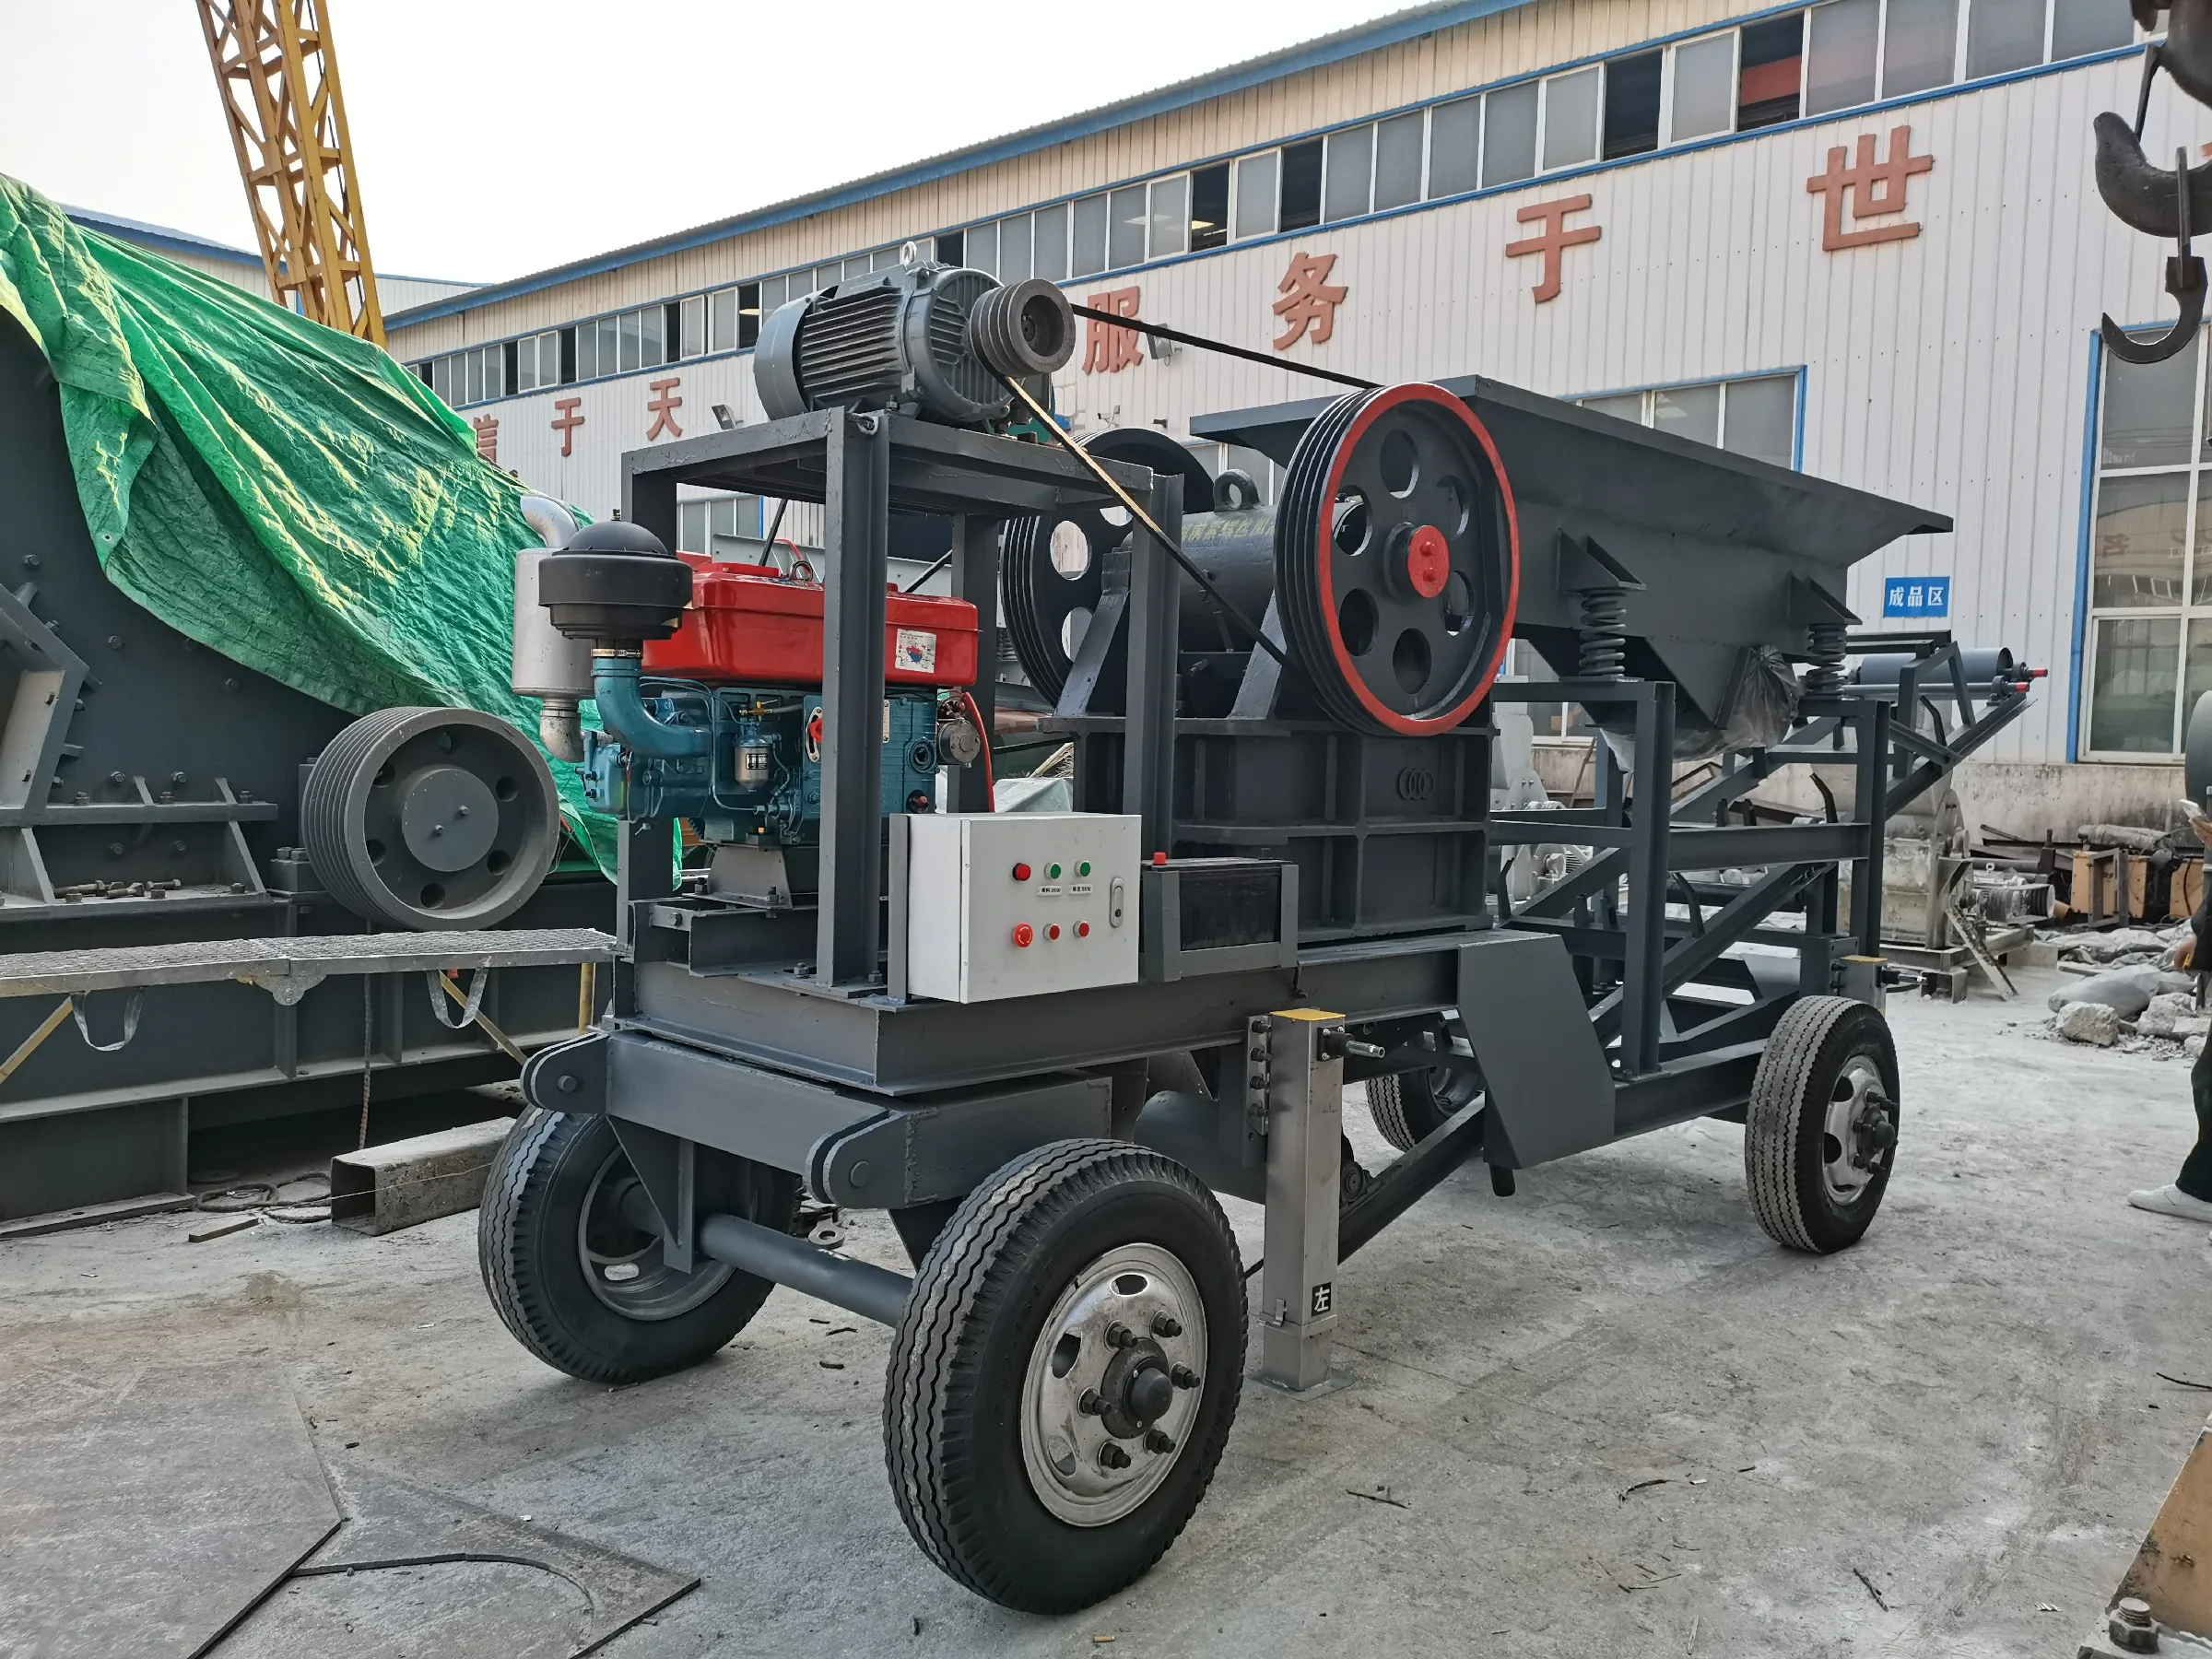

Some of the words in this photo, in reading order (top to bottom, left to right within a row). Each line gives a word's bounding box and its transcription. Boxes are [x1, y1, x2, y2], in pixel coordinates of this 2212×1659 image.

[1888, 585, 1944, 607] 成品区
[1314, 1286, 1330, 1312] 左
